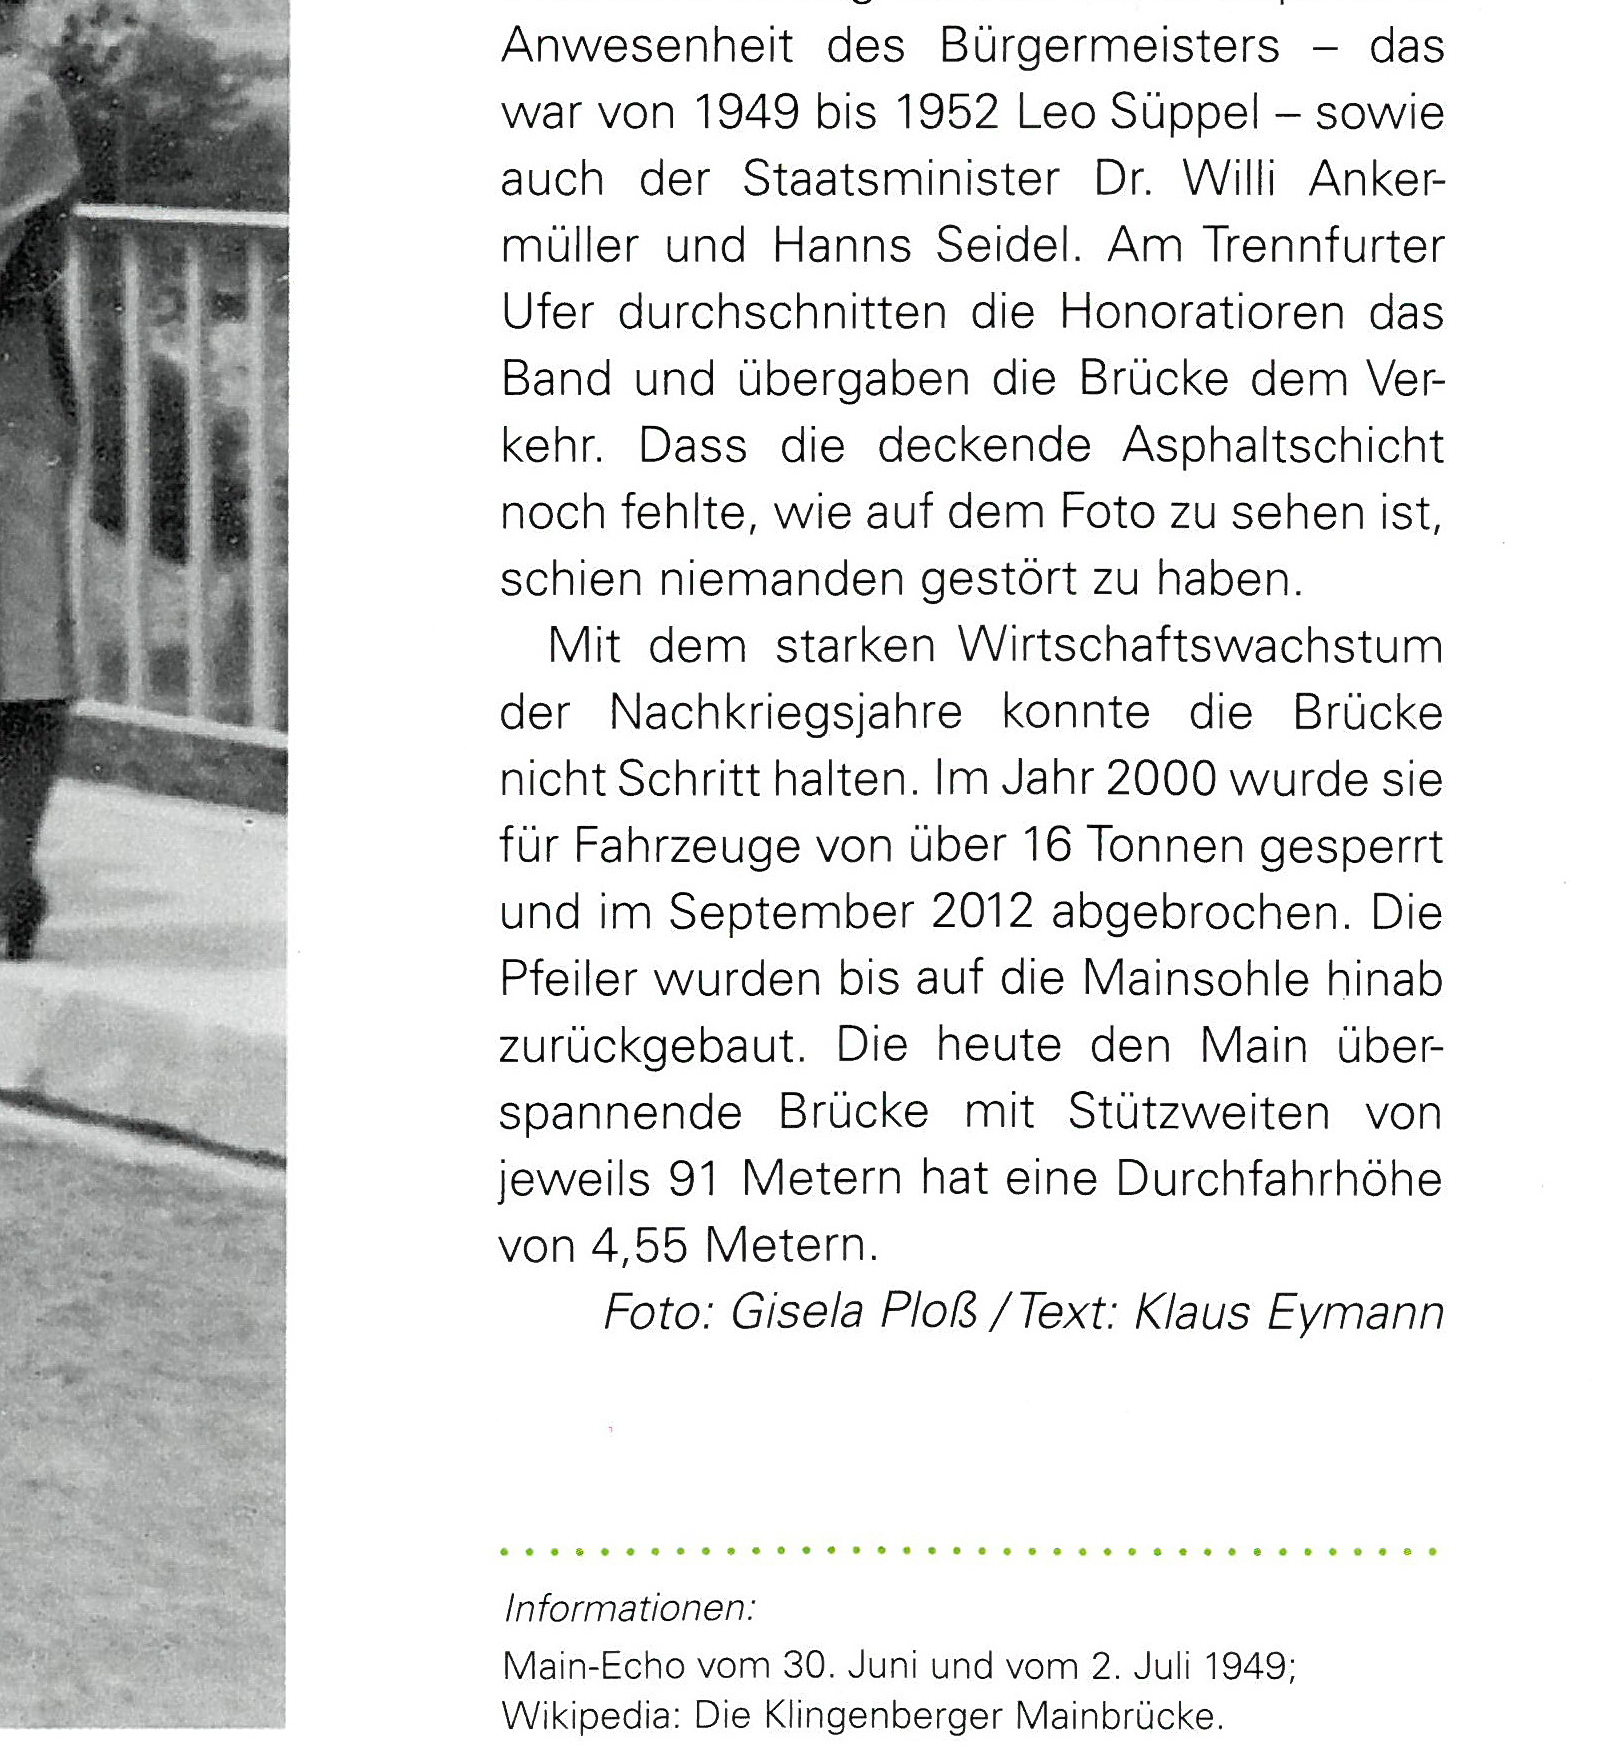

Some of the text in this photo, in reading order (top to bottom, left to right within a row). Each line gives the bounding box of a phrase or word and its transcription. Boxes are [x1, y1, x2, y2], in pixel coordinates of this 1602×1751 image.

[503, 224, 1446, 264] müller und Hanns Seidel. Am Trennfurter
[504, 357, 1446, 406] Band und übergaben die Brücke dem Ver-
[550, 623, 1442, 664] Mit dem starken Wirtschaftswachstum
[501, 757, 1443, 798] nicht Schritt halten. Im Jahr 2000 wurde sie
[501, 890, 1443, 939] und im September 2012 abgebrochen. Die
[499, 1023, 1444, 1073] zurückgebaut. Die heute den Main über-
[496, 1156, 1442, 1206] jeweils 91 Metern hat eine Durchfahrhöhe
[604, 1292, 714, 1330] Foto:
[732, 1290, 863, 1330] Gisela
[881, 1289, 977, 1329] Ploß
[1135, 1291, 1251, 1331] Klaus
[1268, 1292, 1444, 1339] Eymann
[505, 1592, 756, 1623] Informationen:
[504, 1648, 1295, 1685] Main-Echo vom 30. Juni und vom 2. Juli 1949;
[501, 1698, 1223, 1737] Wikipedia: Die Klingenberger Mainbrücke.
